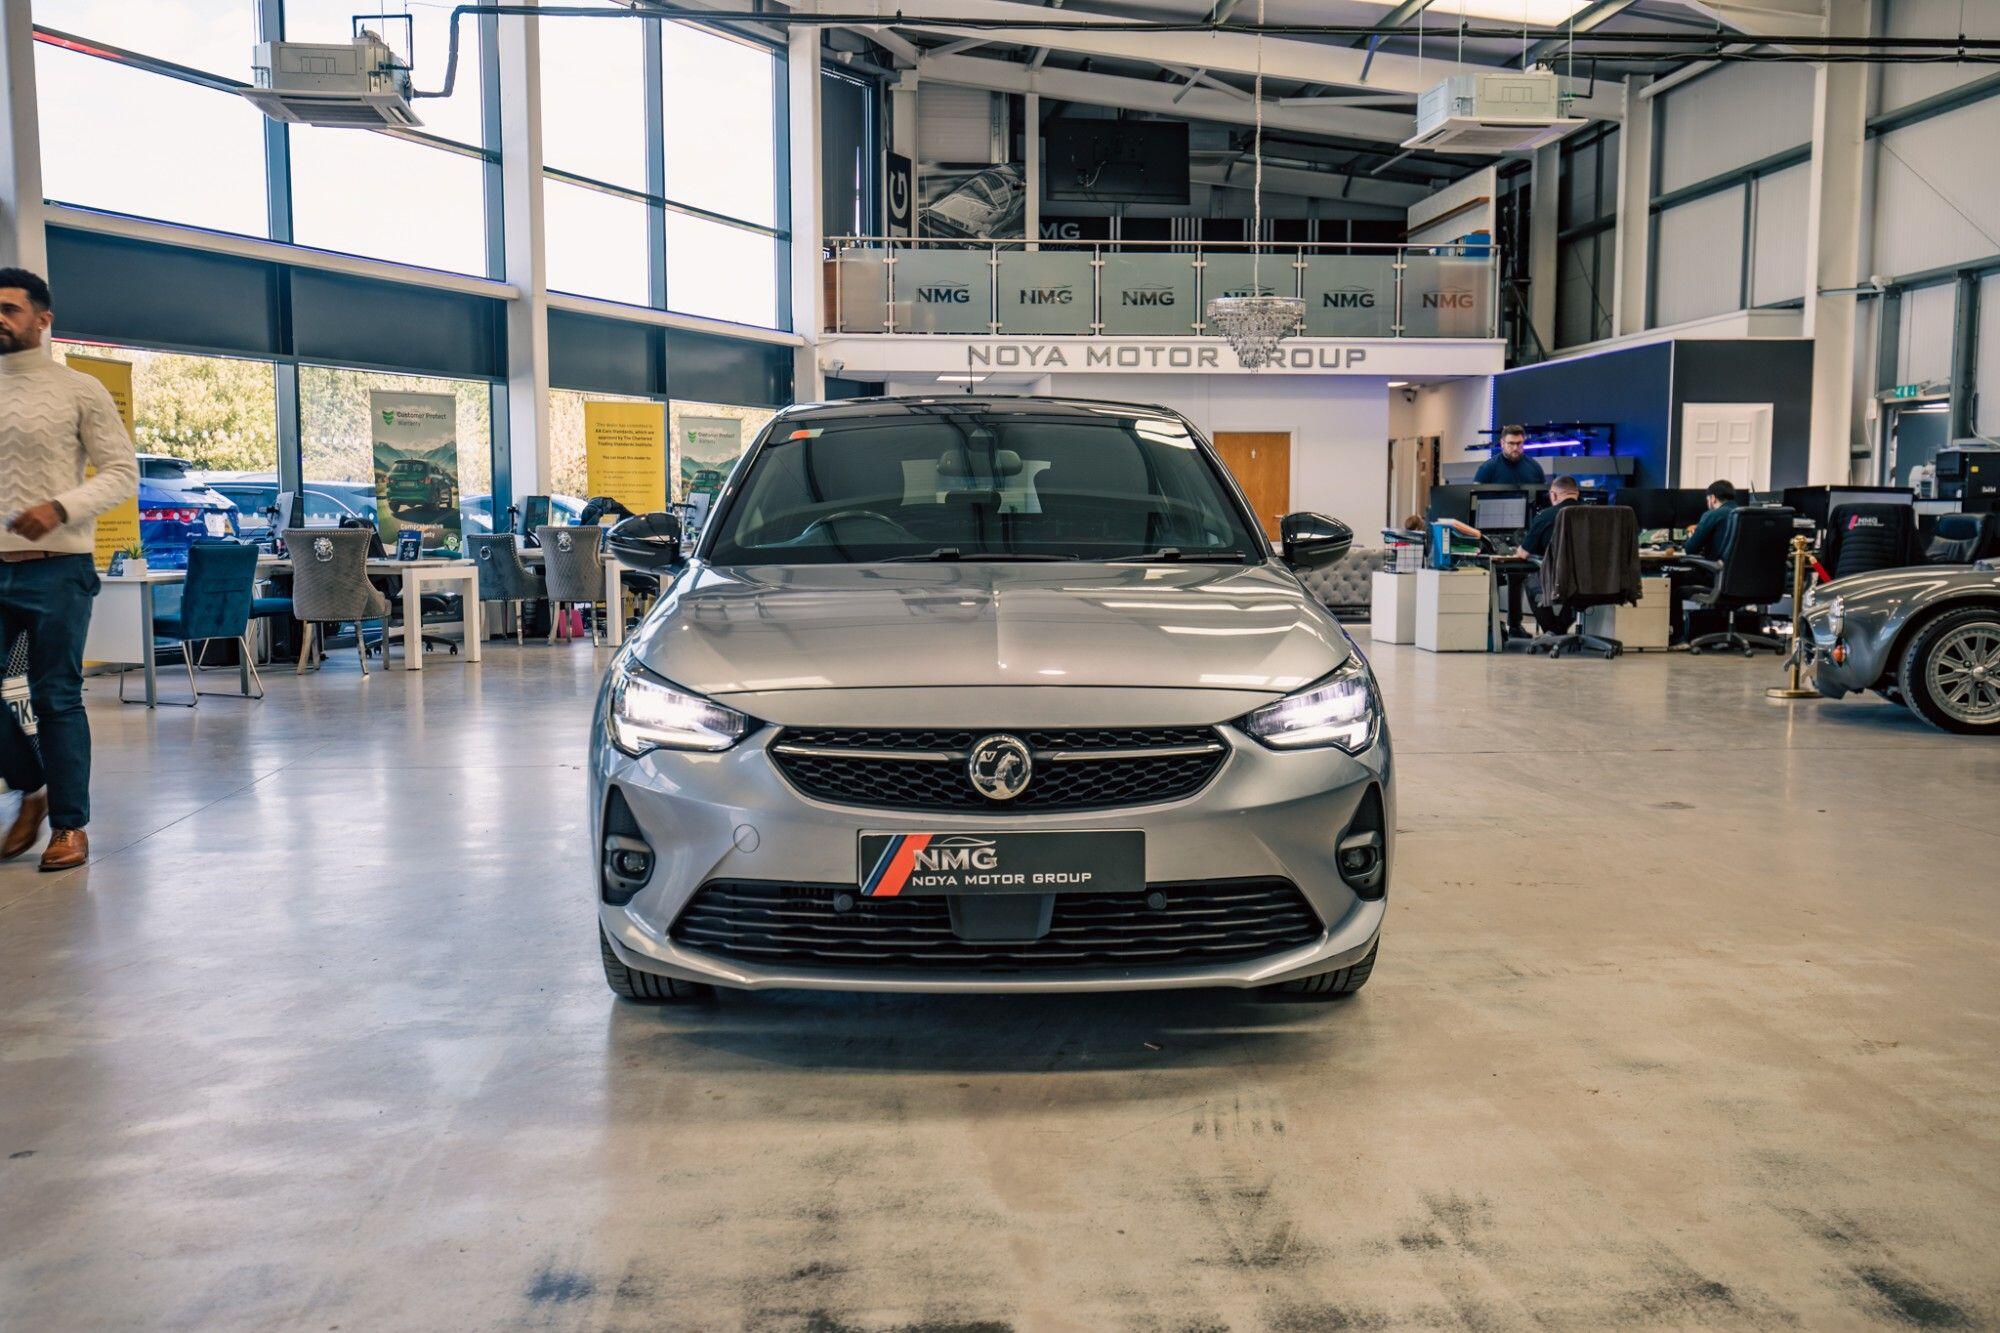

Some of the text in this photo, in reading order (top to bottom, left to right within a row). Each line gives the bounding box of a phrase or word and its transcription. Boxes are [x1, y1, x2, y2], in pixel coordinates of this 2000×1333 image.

[917, 288, 970, 303] NMG
[1019, 289, 1072, 304] NMG
[1122, 291, 1175, 306] NMG
[1323, 293, 1375, 308] NMG
[1422, 293, 1474, 308] NMG
[967, 345, 1068, 367] NOYA
[1087, 346, 1219, 368] MOTOR
[397, 411, 447, 420] Customer Protect
[400, 523, 444, 531] Comprehensive
[913, 847, 998, 872] NMG
[912, 872, 1092, 887] NOYA MOTOR GROUP
